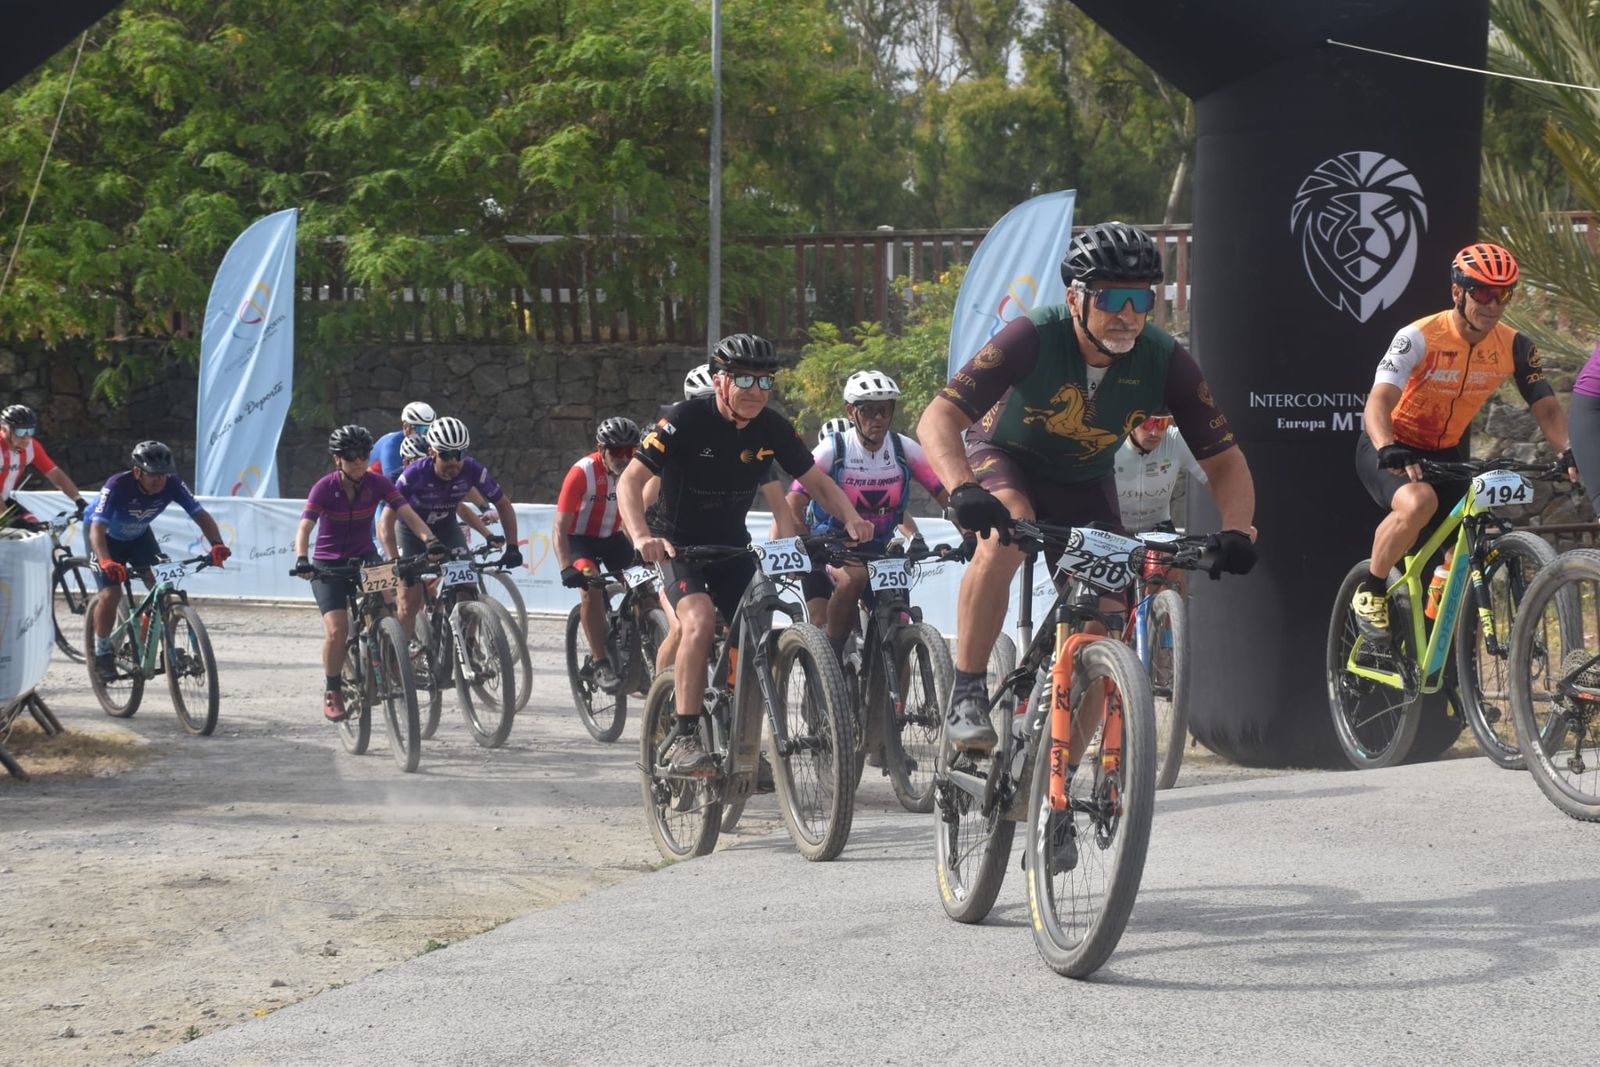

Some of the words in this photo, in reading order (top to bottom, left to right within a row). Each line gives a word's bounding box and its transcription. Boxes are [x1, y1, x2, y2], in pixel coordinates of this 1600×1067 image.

[1249, 391, 1370, 408] INTERCONTIN
[1277, 417, 1326, 432] Europa
[1331, 411, 1367, 432] MT
[1486, 483, 1526, 505] 194
[768, 550, 804, 572] 229
[159, 566, 186, 582] 243
[448, 569, 475, 583] 246
[877, 571, 908, 588] 250
[366, 577, 399, 592] 272-2
